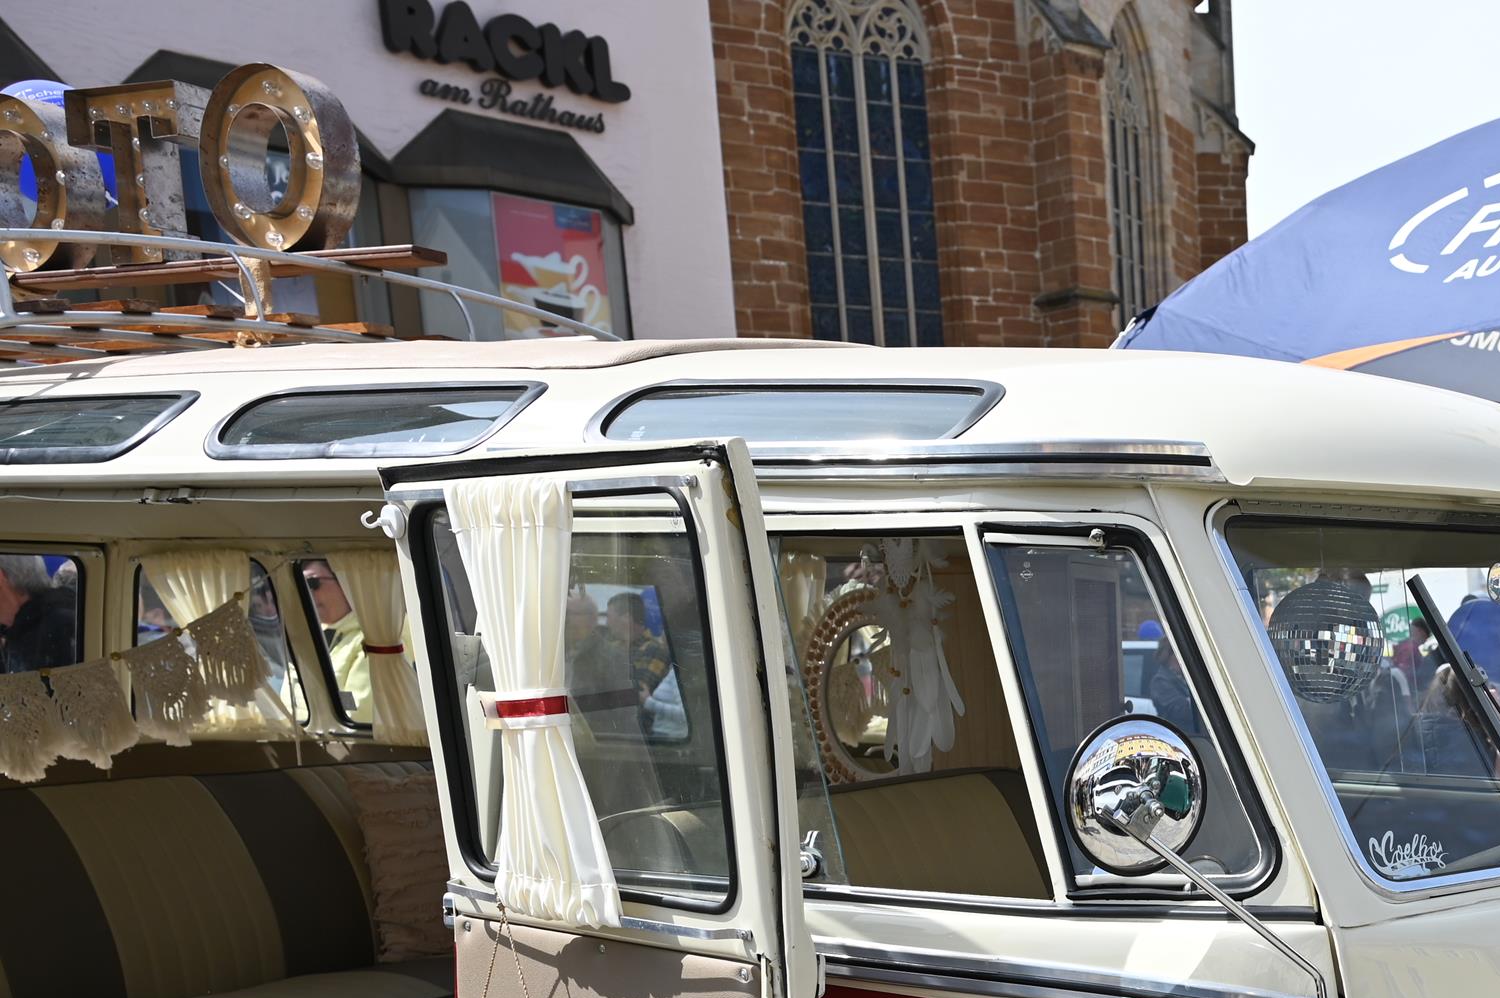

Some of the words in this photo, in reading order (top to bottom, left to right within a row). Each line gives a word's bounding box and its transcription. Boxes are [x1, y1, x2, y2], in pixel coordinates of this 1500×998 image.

[378, 0, 632, 104] RACKL
[418, 78, 473, 105] am
[478, 78, 606, 134] Rathaus
